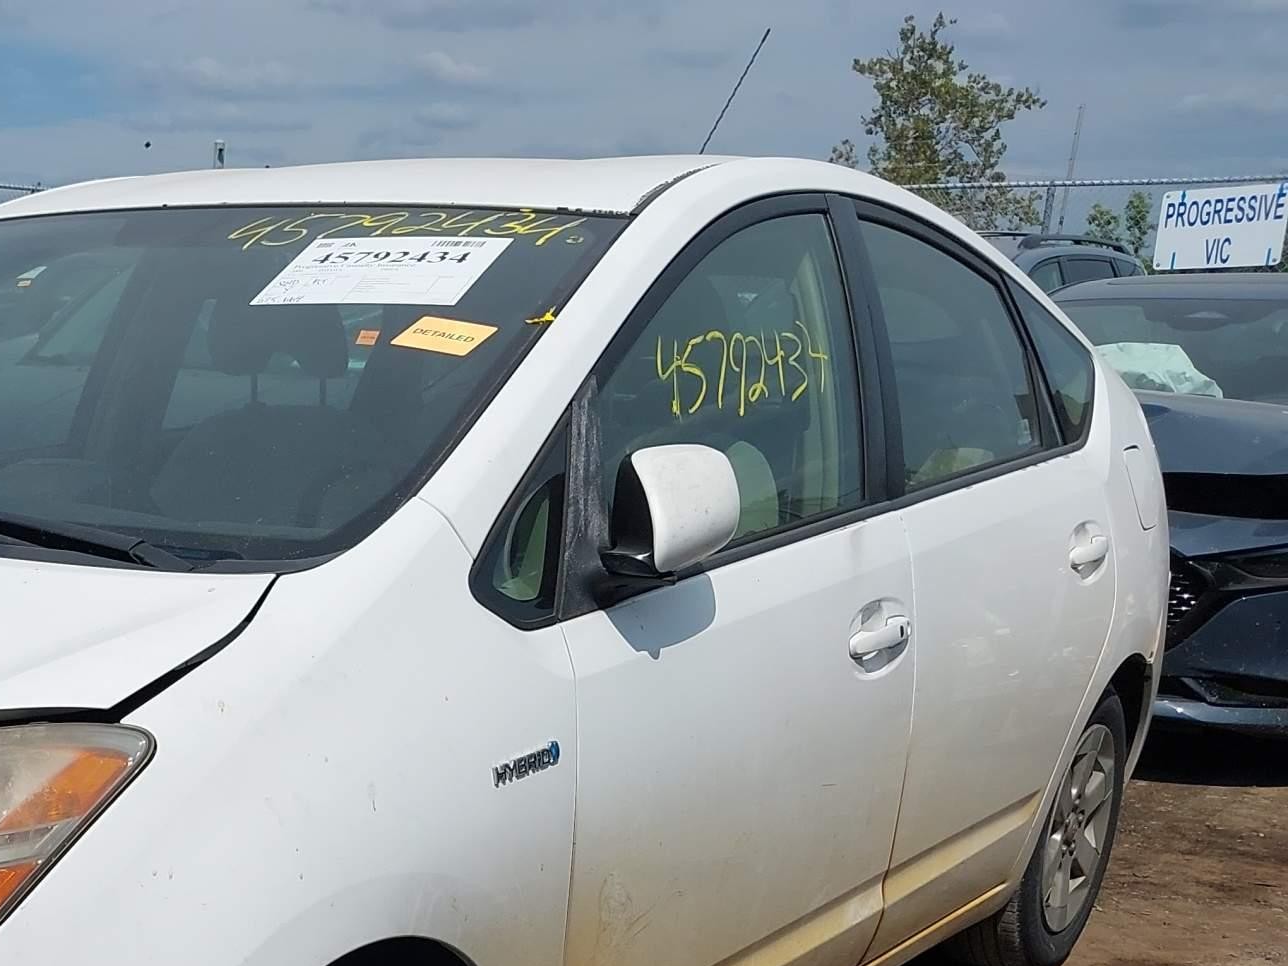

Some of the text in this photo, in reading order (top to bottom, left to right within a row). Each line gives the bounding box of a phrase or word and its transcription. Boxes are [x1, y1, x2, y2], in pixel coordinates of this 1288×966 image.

[227, 207, 588, 251] 45792434
[1164, 192, 1287, 229] PROGRESSIVE
[312, 251, 471, 265] 45792434
[1205, 237, 1232, 265] VIC
[412, 327, 475, 344] DETAILED
[656, 320, 829, 422] 45792434
[492, 748, 552, 788] HYBRID
